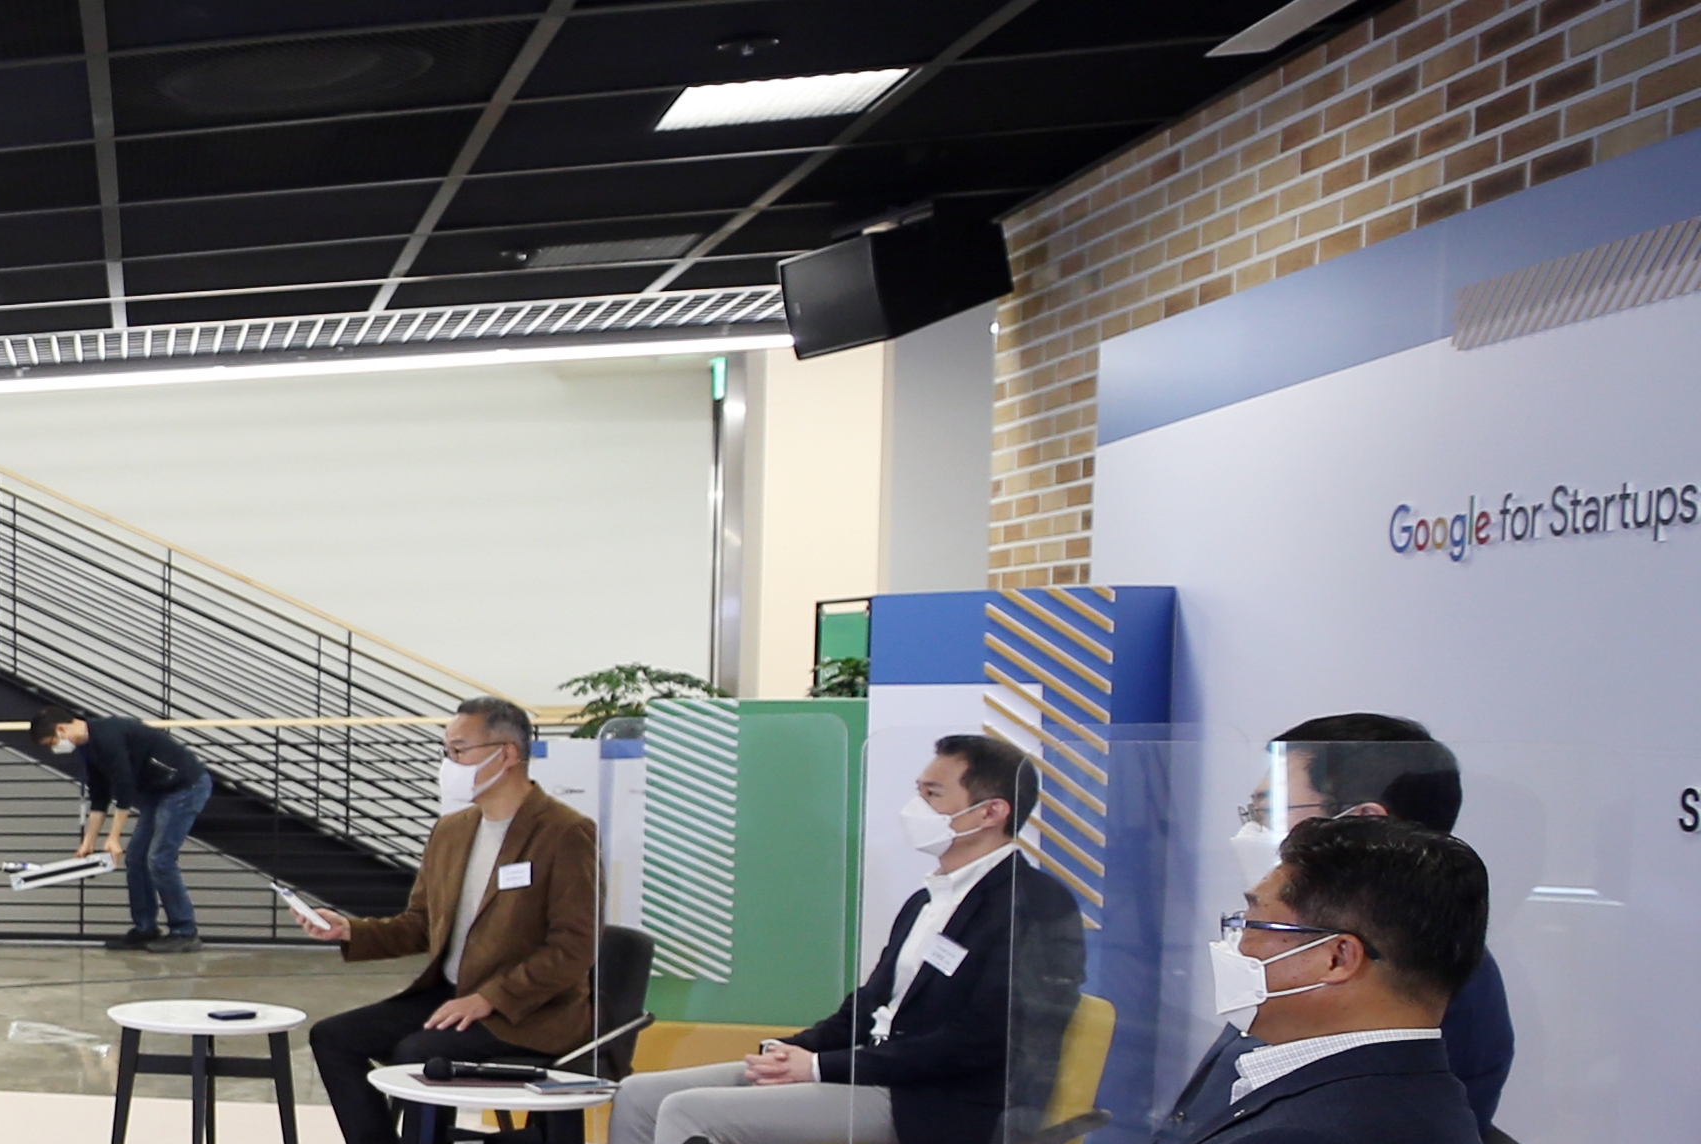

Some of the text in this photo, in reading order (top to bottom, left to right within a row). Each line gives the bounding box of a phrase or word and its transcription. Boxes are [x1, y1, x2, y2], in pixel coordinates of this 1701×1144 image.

[1388, 481, 1700, 562] Google for Startups
